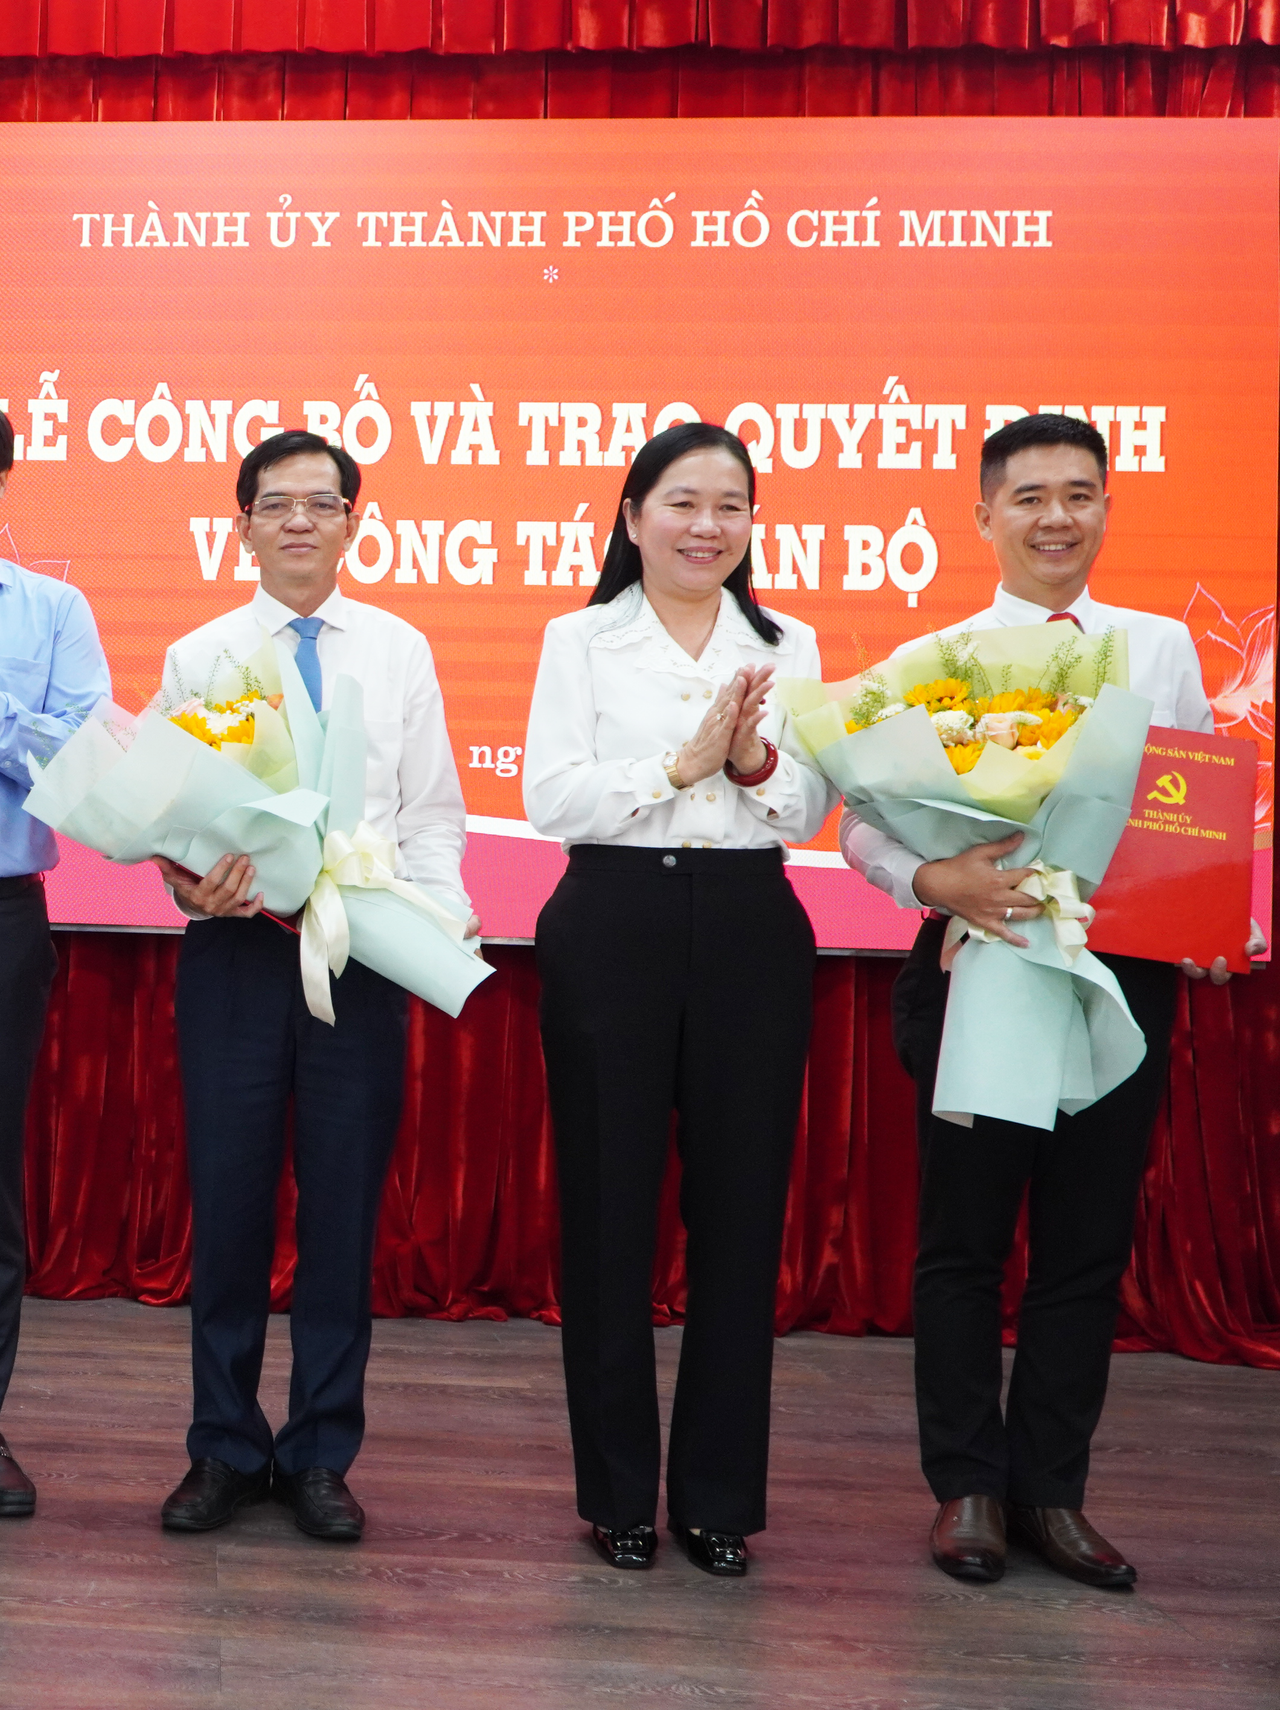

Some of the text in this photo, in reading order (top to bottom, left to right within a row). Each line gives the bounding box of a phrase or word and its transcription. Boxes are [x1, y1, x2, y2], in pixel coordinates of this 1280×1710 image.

[72, 190, 1053, 249] THÀNH ỦY THÀNH PHỐ HỒ CHÍ MINH
[410, 383, 500, 466] VÀ
[724, 375, 967, 474] QUYẾT
[189, 516, 262, 582] V
[337, 501, 498, 586] ÔNG
[516, 502, 613, 587] TÁ
[842, 507, 939, 608] BỘ
[1144, 743, 1235, 766] ỘNG SẢN VIỆT NAM
[1143, 809, 1177, 822] THÀNH
[1143, 820, 1164, 831] PHỐ
[1165, 822, 1180, 833] HỒ
[1181, 826, 1199, 837] CHÍ
[1199, 829, 1227, 841] MINH
